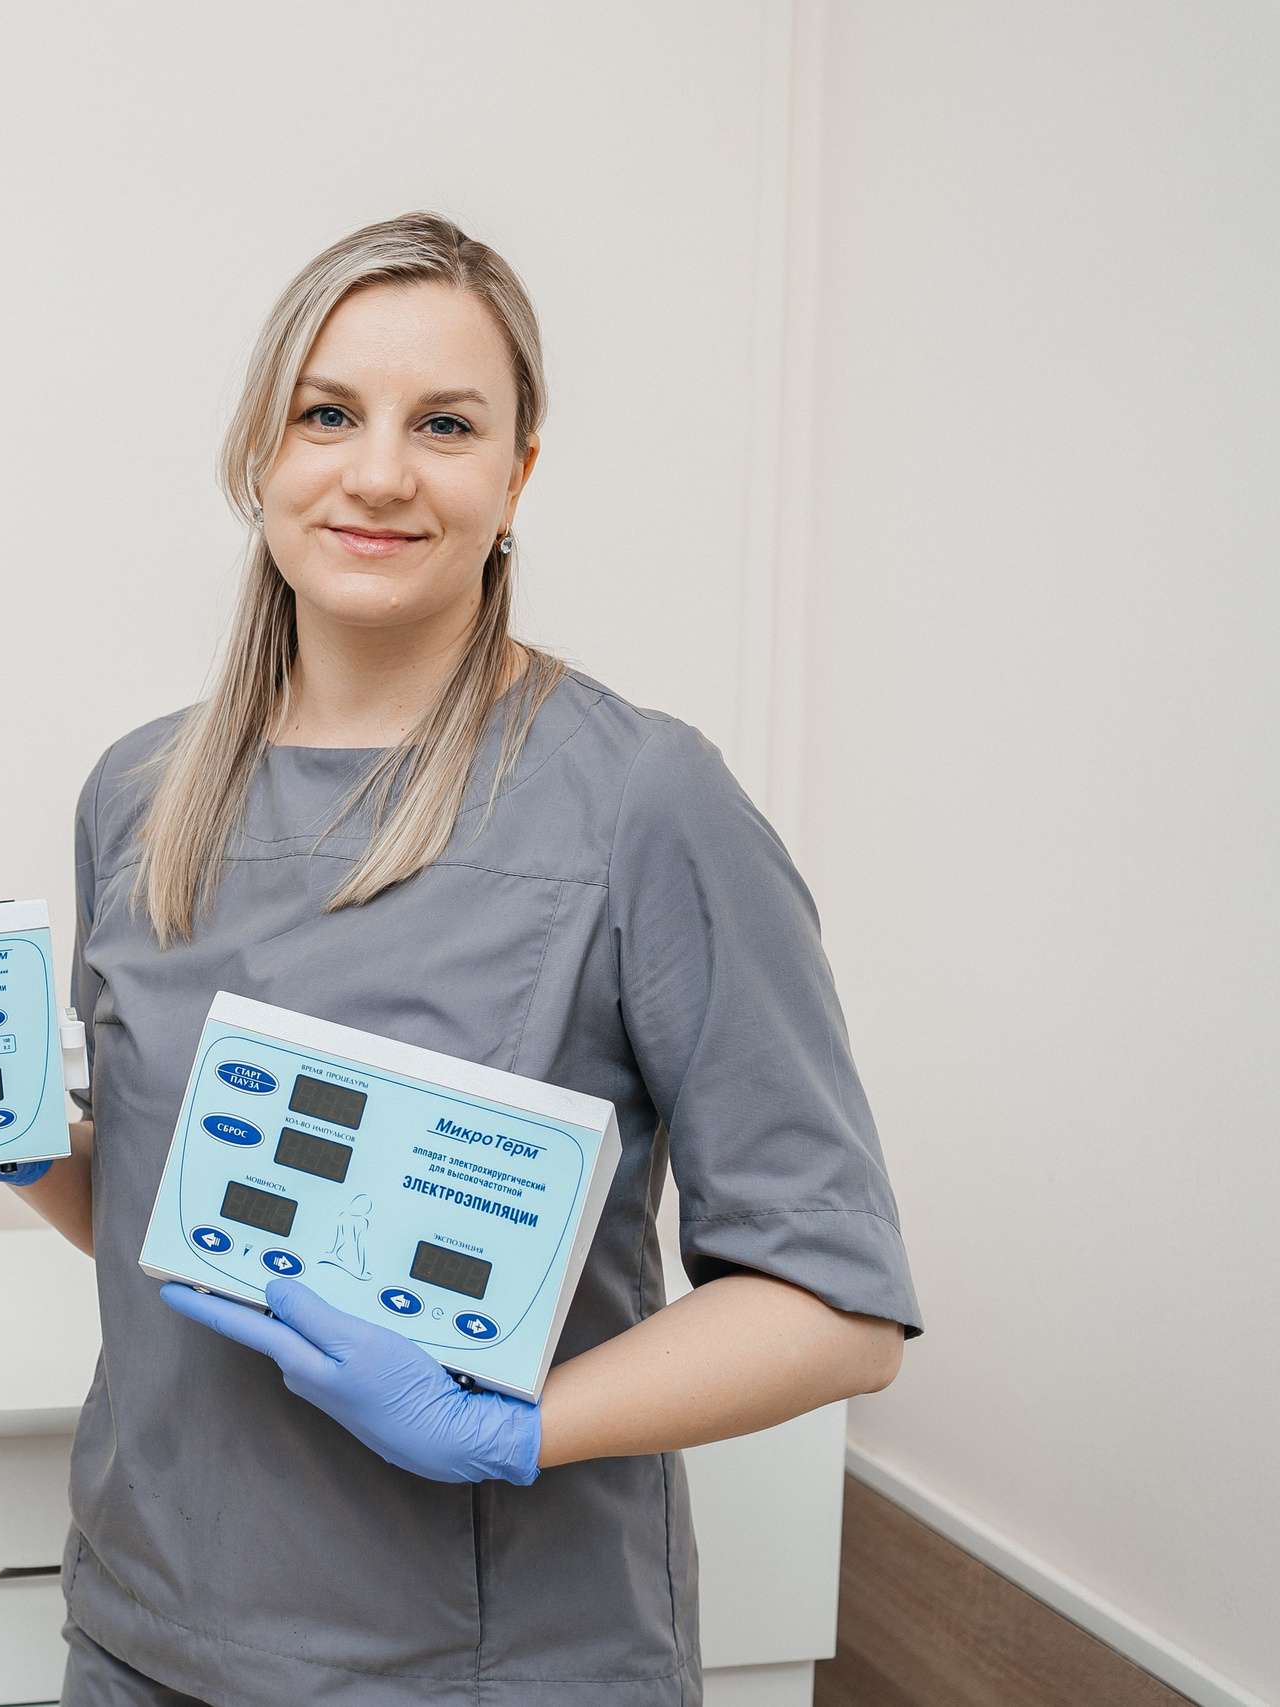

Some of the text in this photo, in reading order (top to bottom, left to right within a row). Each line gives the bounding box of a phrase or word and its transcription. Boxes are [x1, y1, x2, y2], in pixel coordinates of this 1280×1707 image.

[230, 1075, 260, 1091] ПАУЗА
[234, 1065, 262, 1080] СТАРТ
[300, 1064, 369, 1089] ВРЕМЯ ПРОЦЕДУРЫ
[216, 1122, 249, 1139] СБРОС
[284, 1116, 356, 1143] КОЛ-ВО ИМПУЛЬСОВ
[435, 1117, 539, 1160] МикроТерм
[412, 1146, 546, 1193] аппарат электрохирургический
[428, 1163, 523, 1198] для высокочастотной
[245, 1174, 287, 1193] МОЩНОСТЬ
[402, 1174, 539, 1228] ЭЛЕКТРОЭПИЛЯЦИИ
[433, 1232, 485, 1254] ЭКСПОЗИЦИЯ
